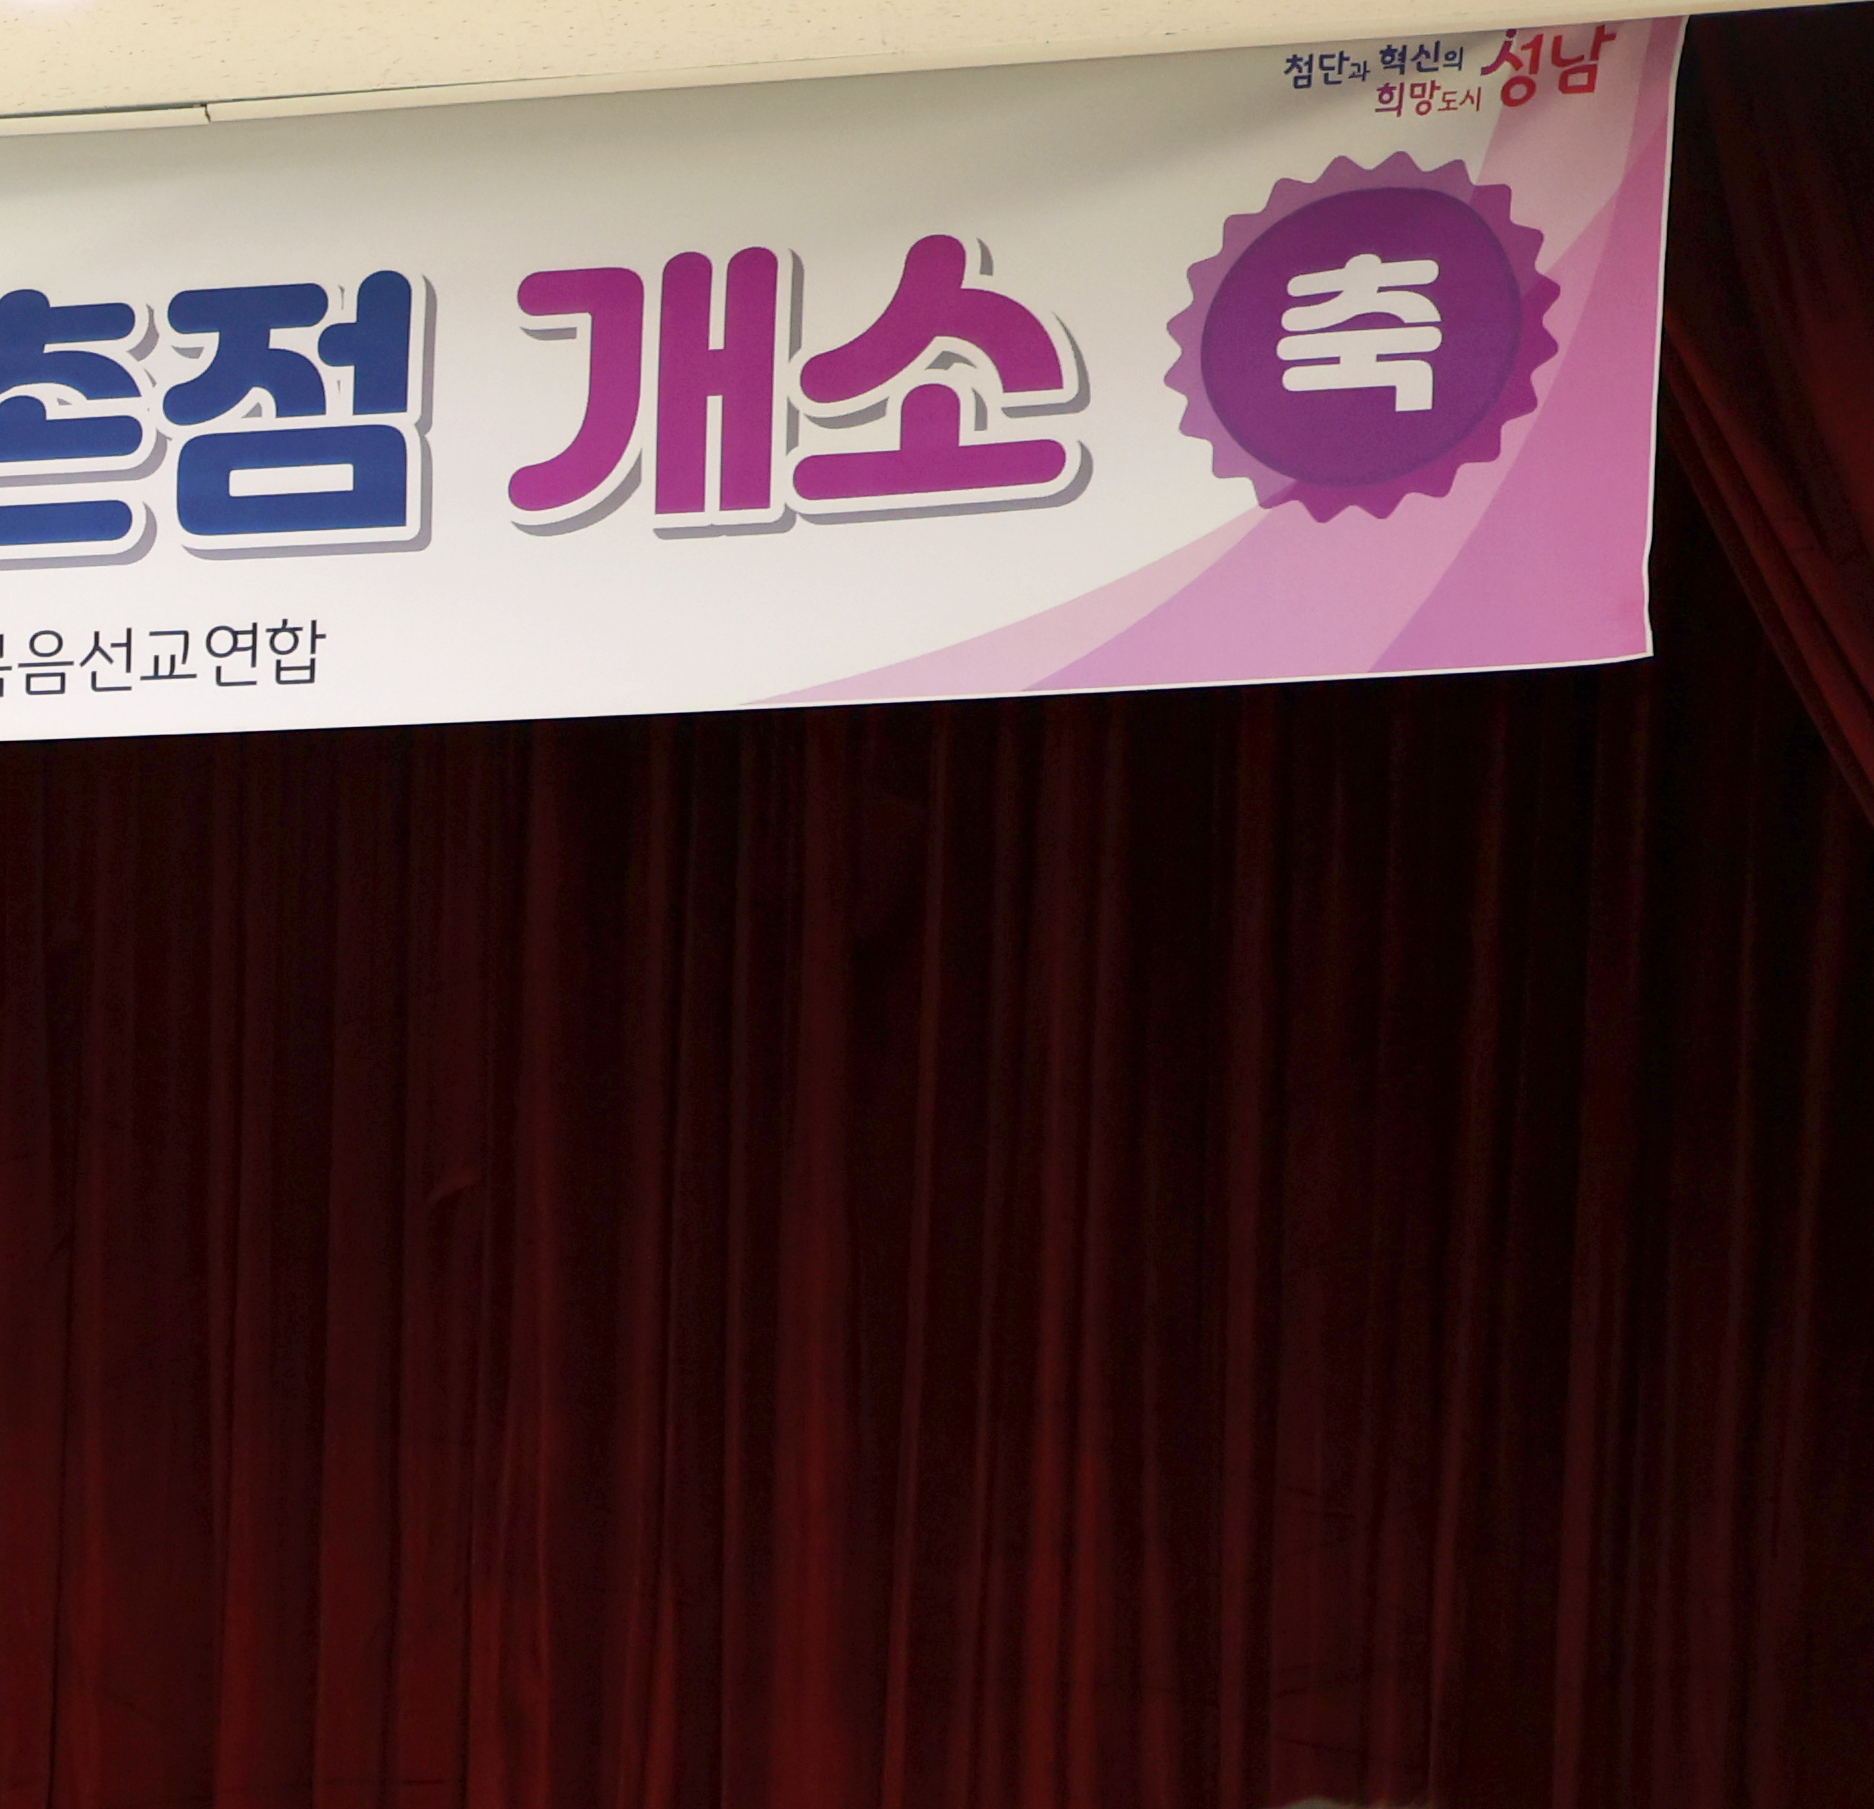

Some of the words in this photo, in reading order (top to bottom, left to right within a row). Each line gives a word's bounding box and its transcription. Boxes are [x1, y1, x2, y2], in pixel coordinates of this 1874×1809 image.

[1283, 49, 1371, 89] 첨단과
[1379, 40, 1464, 75] 혁신의
[1374, 80, 1483, 118] 희망도시
[1480, 24, 1617, 108] 성남
[506, 233, 1068, 514] 개소
[1275, 253, 1442, 412] 축
